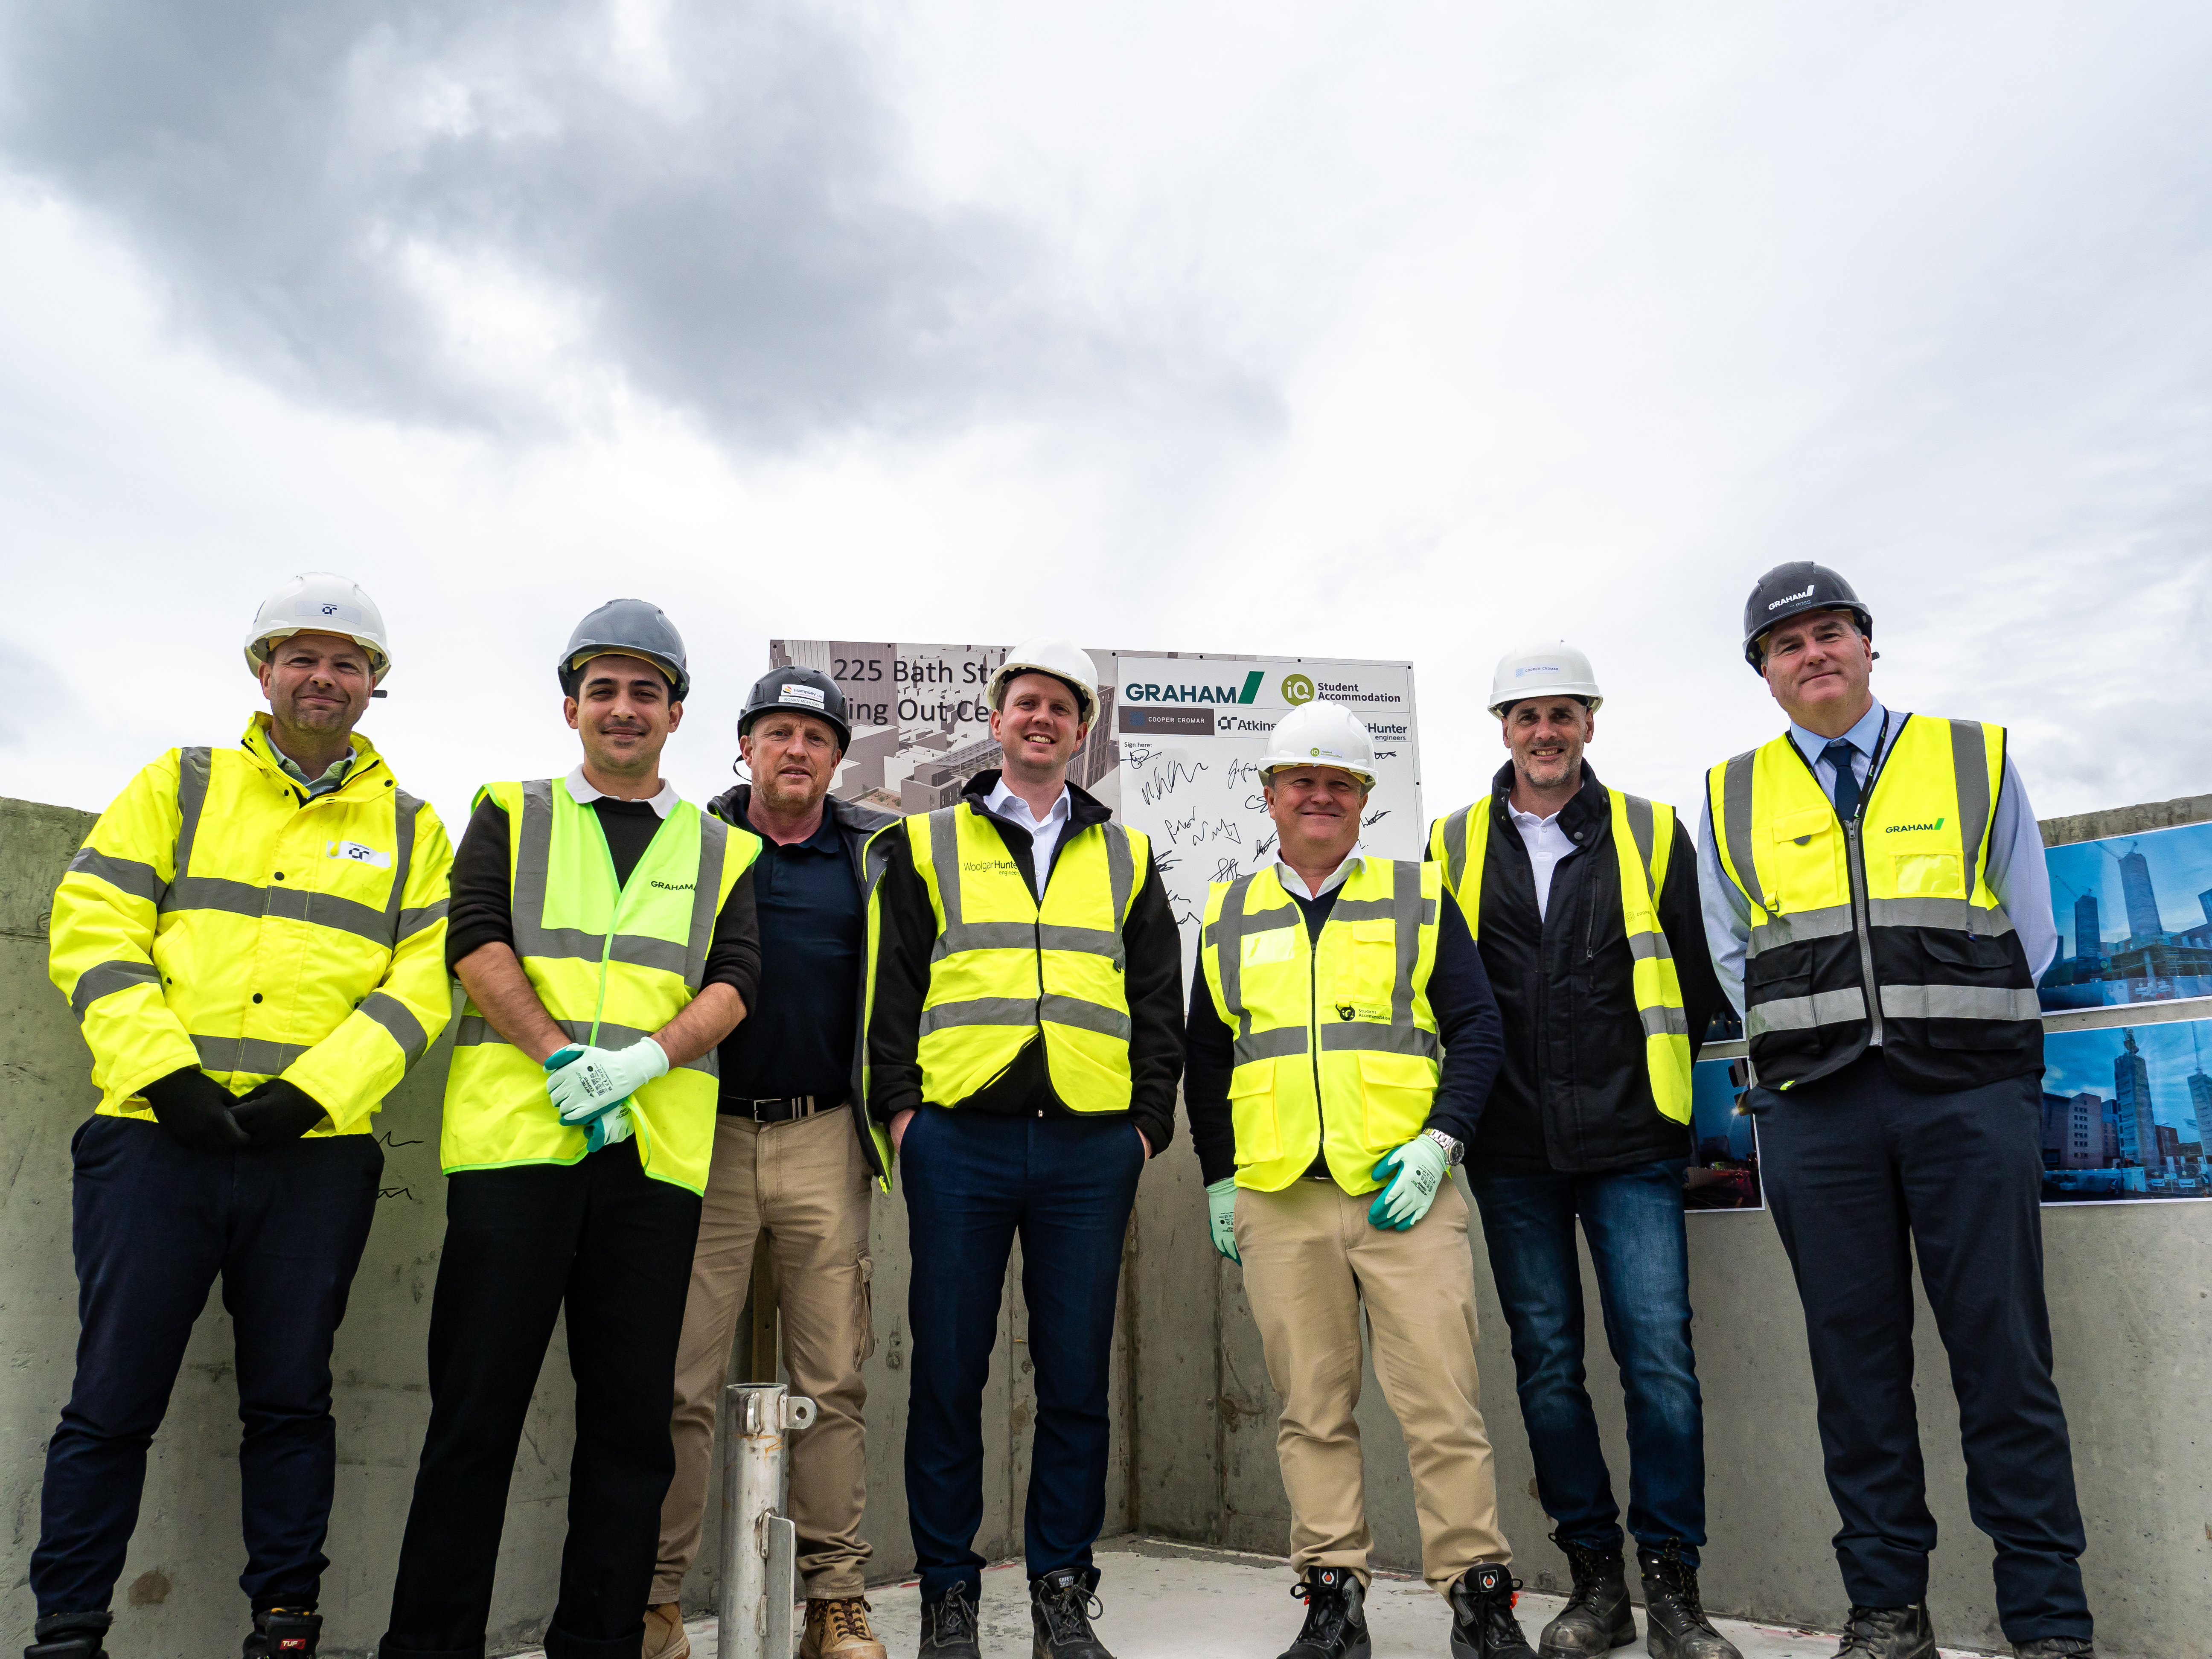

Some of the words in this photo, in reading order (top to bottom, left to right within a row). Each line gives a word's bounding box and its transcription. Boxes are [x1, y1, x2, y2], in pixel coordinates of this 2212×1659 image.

[1768, 591, 1806, 610] GRAHAM
[833, 659, 882, 681] 225
[894, 661, 953, 683] Bath
[794, 688, 816, 696] Hampsey
[1318, 683, 1359, 692] Student
[1126, 683, 1237, 704] GRAHAM
[1318, 692, 1401, 702] Accommodation
[848, 697, 888, 725] ing
[898, 699, 948, 722] Out
[957, 700, 989, 722] Ce
[1237, 720, 1279, 731] Atkins
[1364, 723, 1407, 734] Hunter
[1886, 824, 1933, 833] GRAHAM
[963, 860, 1018, 872] WoolgarHunte
[651, 881, 693, 891] GRAHAM
